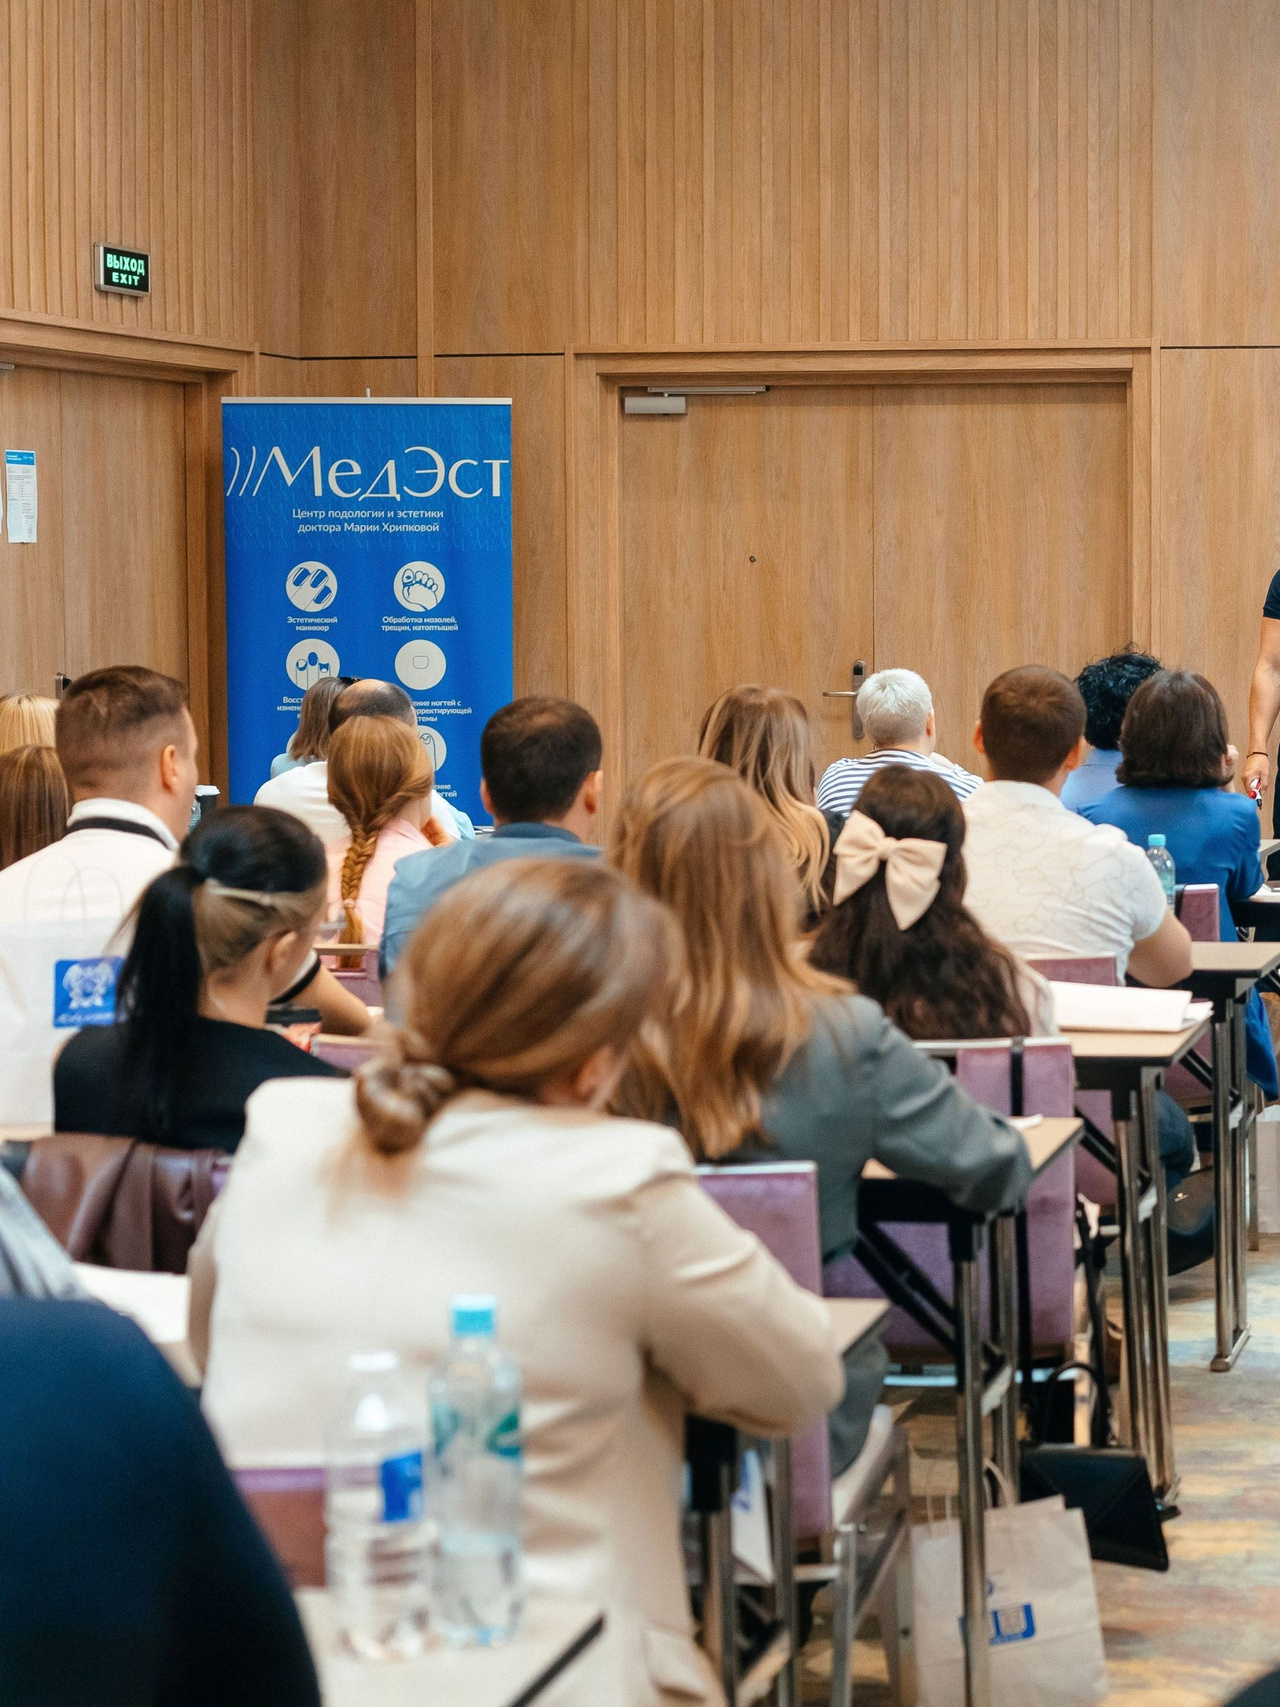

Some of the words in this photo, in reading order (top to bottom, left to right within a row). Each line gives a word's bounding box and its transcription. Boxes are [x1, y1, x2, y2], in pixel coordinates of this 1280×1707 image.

[106, 253, 145, 276] ВЫХОД
[112, 272, 140, 286] EXIT
[292, 508, 325, 519] Центр
[328, 510, 385, 519] подологии
[387, 510, 394, 518] и
[397, 510, 444, 518] эстетики
[297, 523, 341, 533] доктора
[344, 522, 379, 533] Марии
[381, 522, 440, 533] Хрипковой
[286, 616, 338, 624] Эстетический
[382, 616, 422, 624] Обработка
[424, 616, 457, 624] мозолей,
[412, 624, 459, 632] натоптышей
[282, 696, 303, 704] Восст
[430, 699, 456, 707] ногтей
[416, 707, 473, 715] рректирующей
